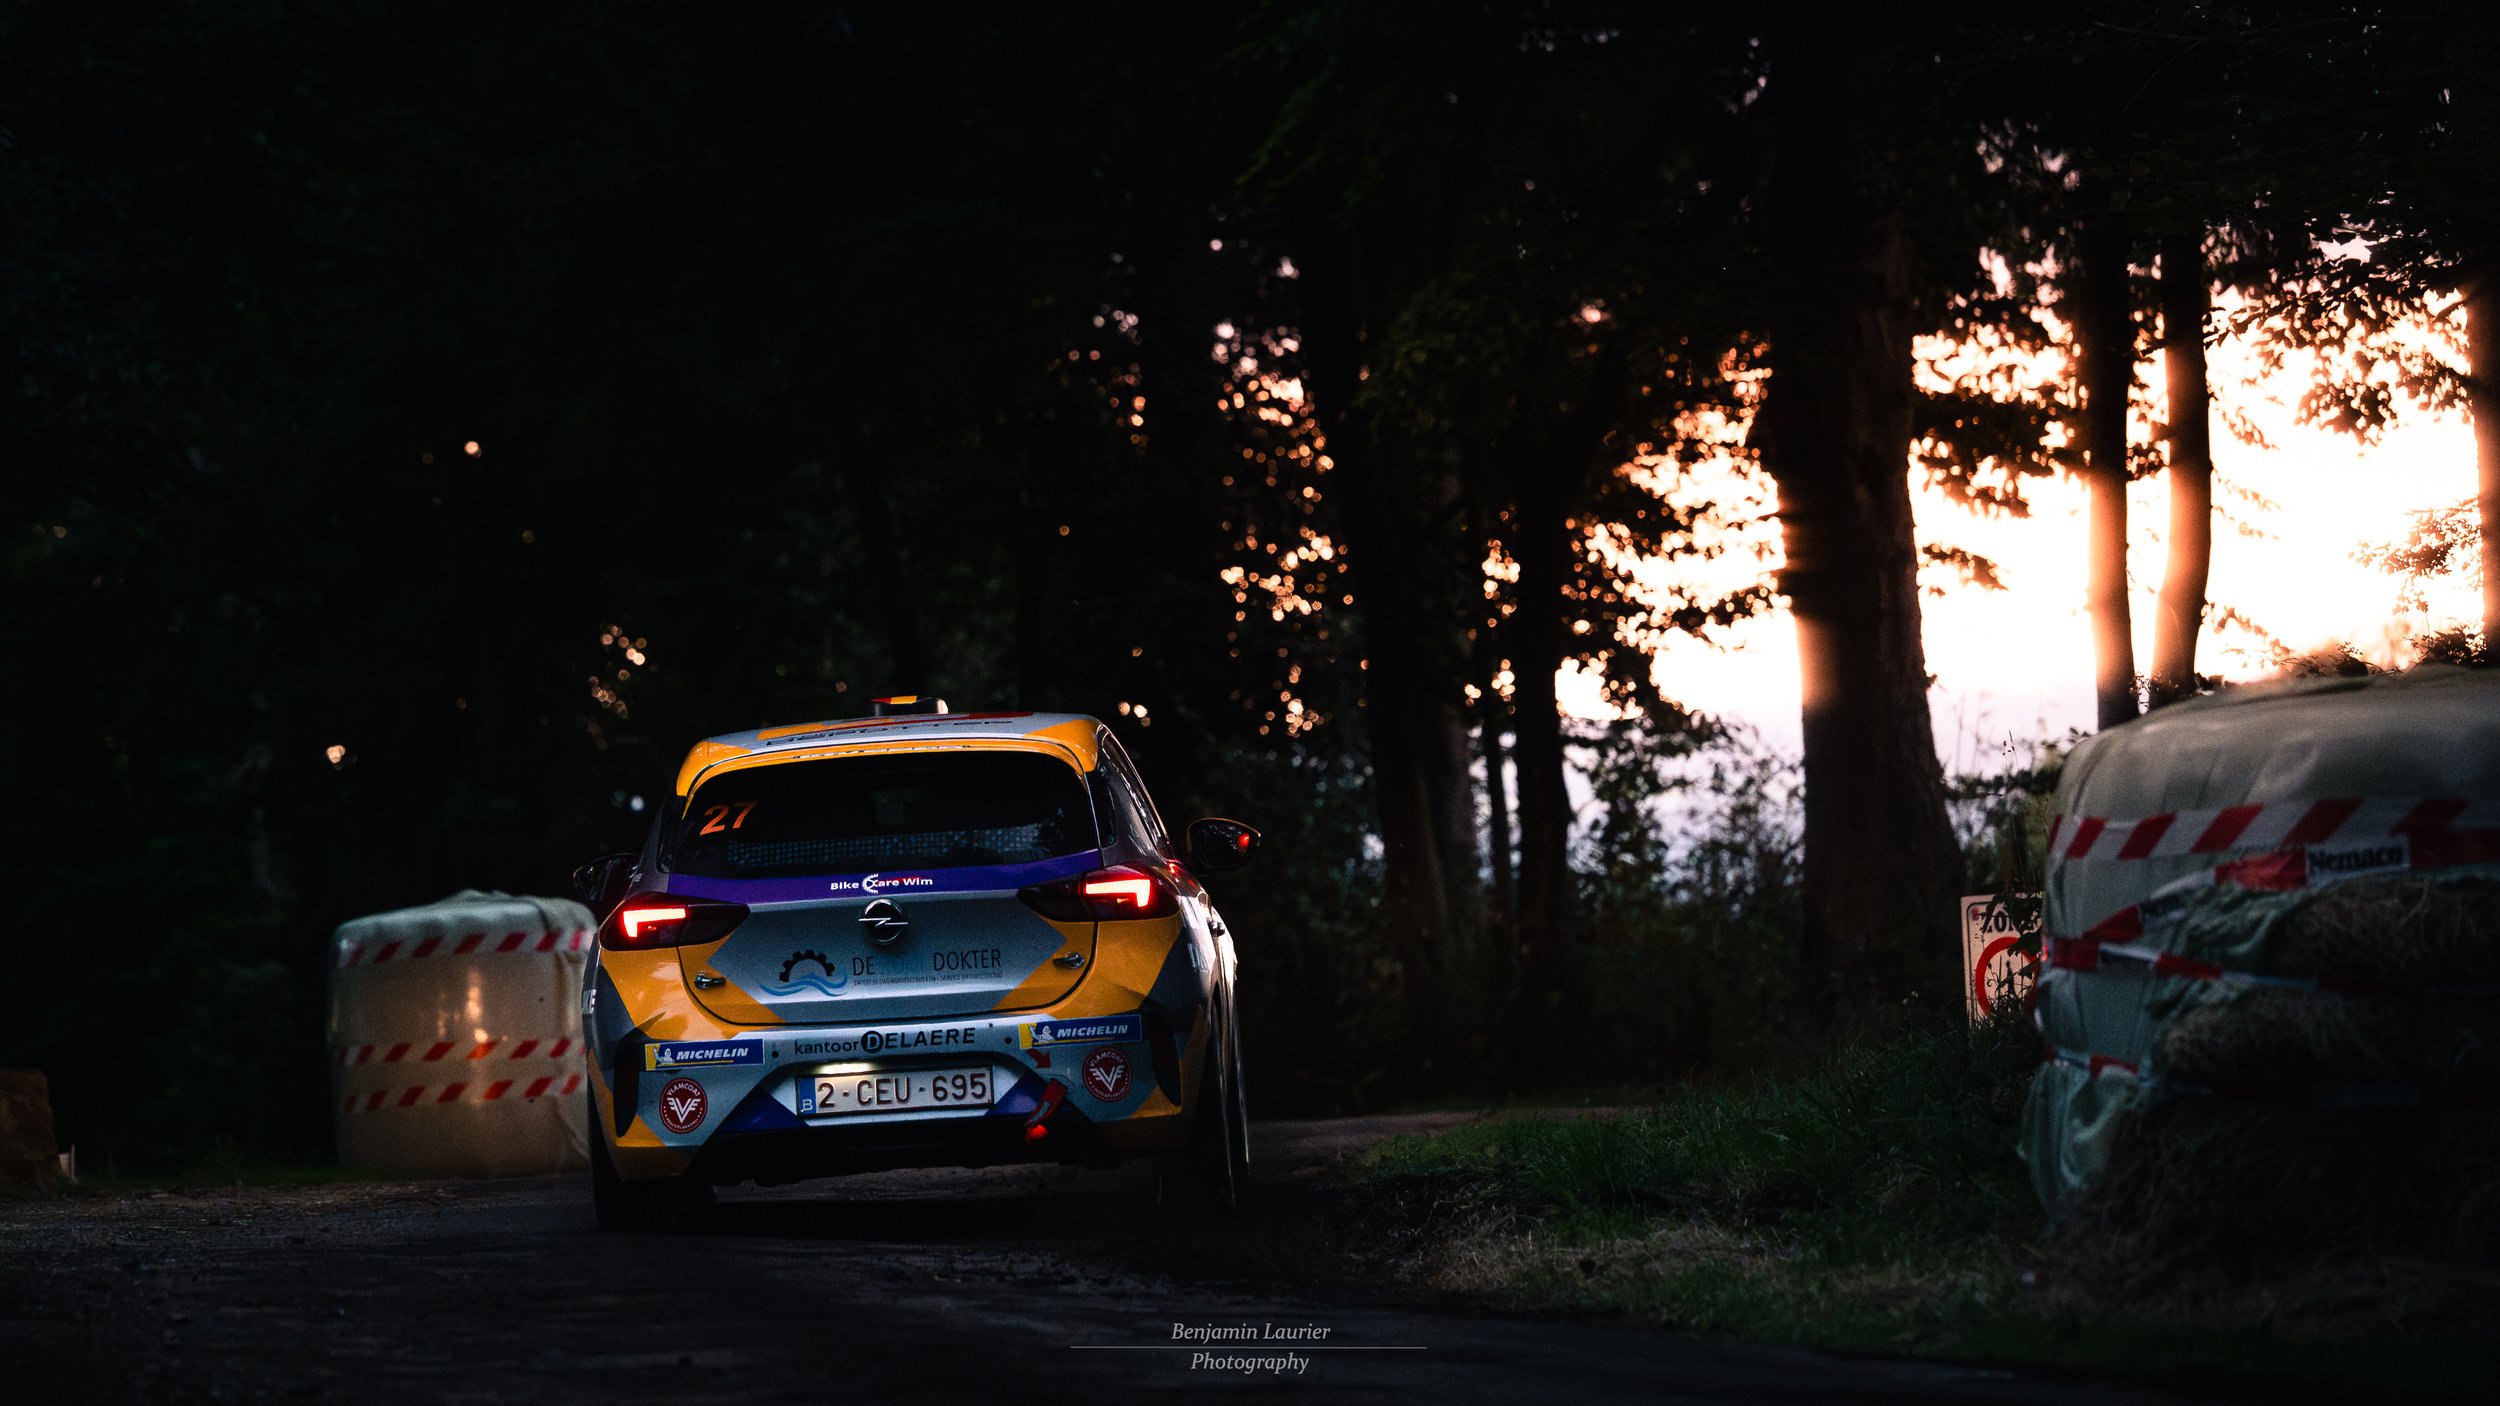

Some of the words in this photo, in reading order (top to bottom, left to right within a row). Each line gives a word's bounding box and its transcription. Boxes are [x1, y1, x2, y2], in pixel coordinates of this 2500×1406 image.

[700, 800, 759, 836] 27
[830, 881, 860, 890] Bike
[903, 877, 933, 886] Wim
[853, 956, 875, 976] DE
[933, 949, 1001, 971] DOKTER
[1057, 1024, 1128, 1038] MICHELIN
[794, 1040, 859, 1055] kantoor
[861, 1028, 976, 1053] DELAERE
[676, 1047, 749, 1060] MICHELIN
[667, 1082, 701, 1097] VLAMCOAT
